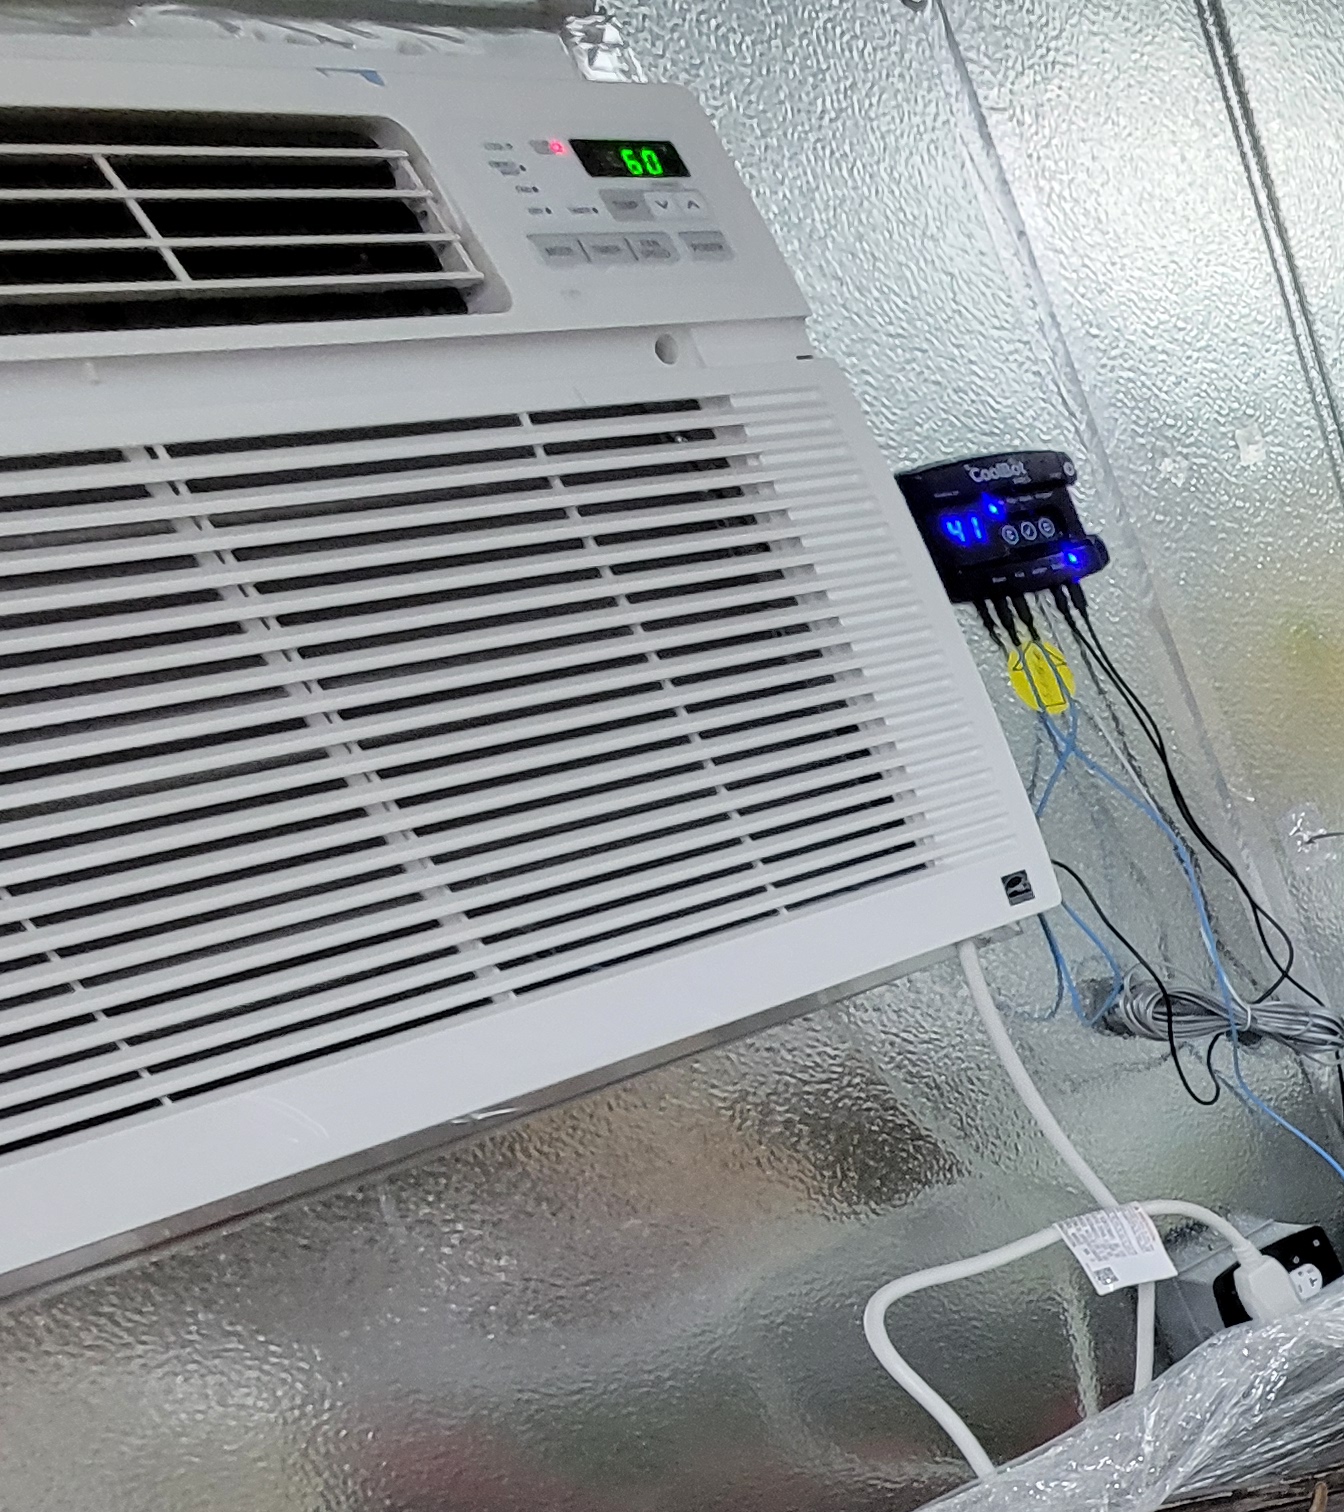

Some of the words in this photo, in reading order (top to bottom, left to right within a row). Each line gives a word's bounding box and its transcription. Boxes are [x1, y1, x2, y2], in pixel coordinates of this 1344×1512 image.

[620, 149, 664, 175] 60
[969, 461, 1027, 482] CoolBot
[945, 515, 983, 543] 41
